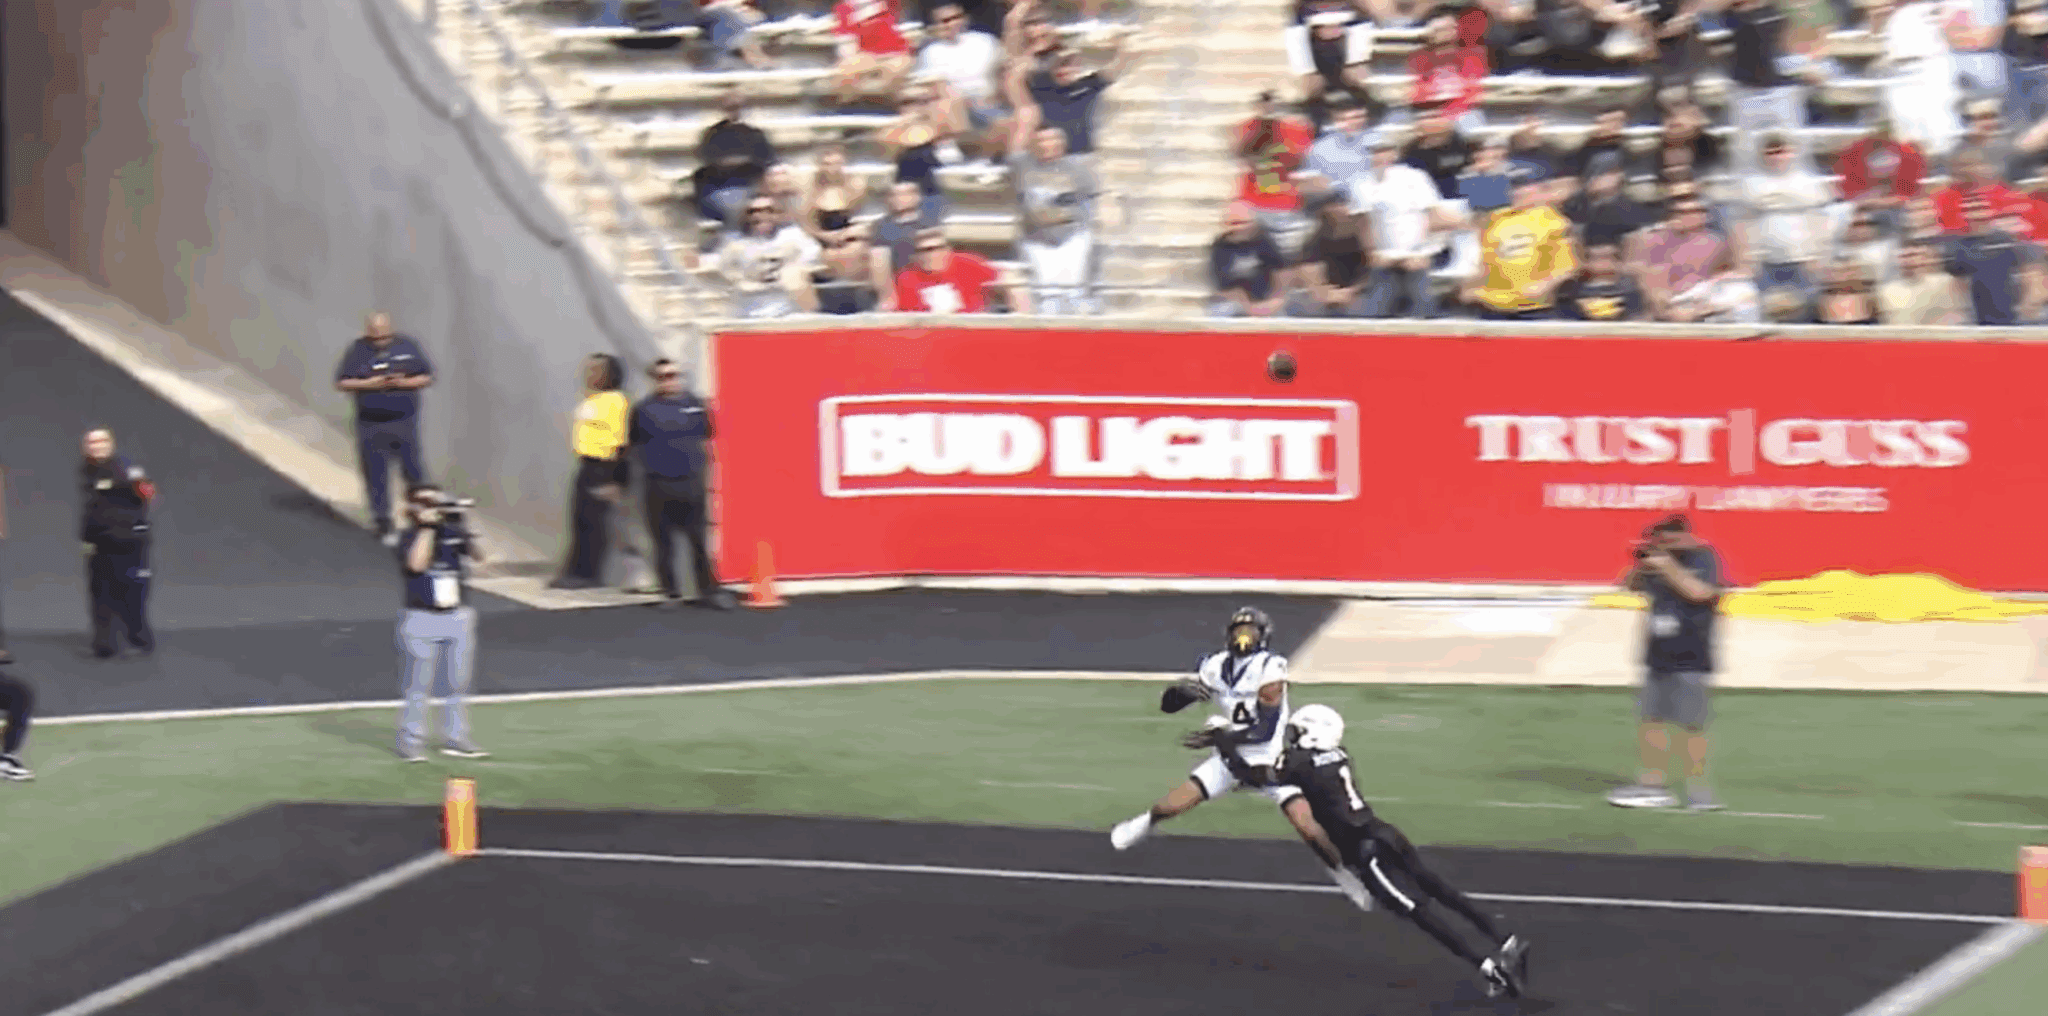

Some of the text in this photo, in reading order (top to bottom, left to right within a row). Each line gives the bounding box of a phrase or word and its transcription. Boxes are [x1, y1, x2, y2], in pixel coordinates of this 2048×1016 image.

[839, 412, 1334, 482] BUD LIGHT
[1464, 413, 1726, 465] TRUST
[1232, 701, 1257, 724] 4
[1339, 764, 1364, 811] 1
